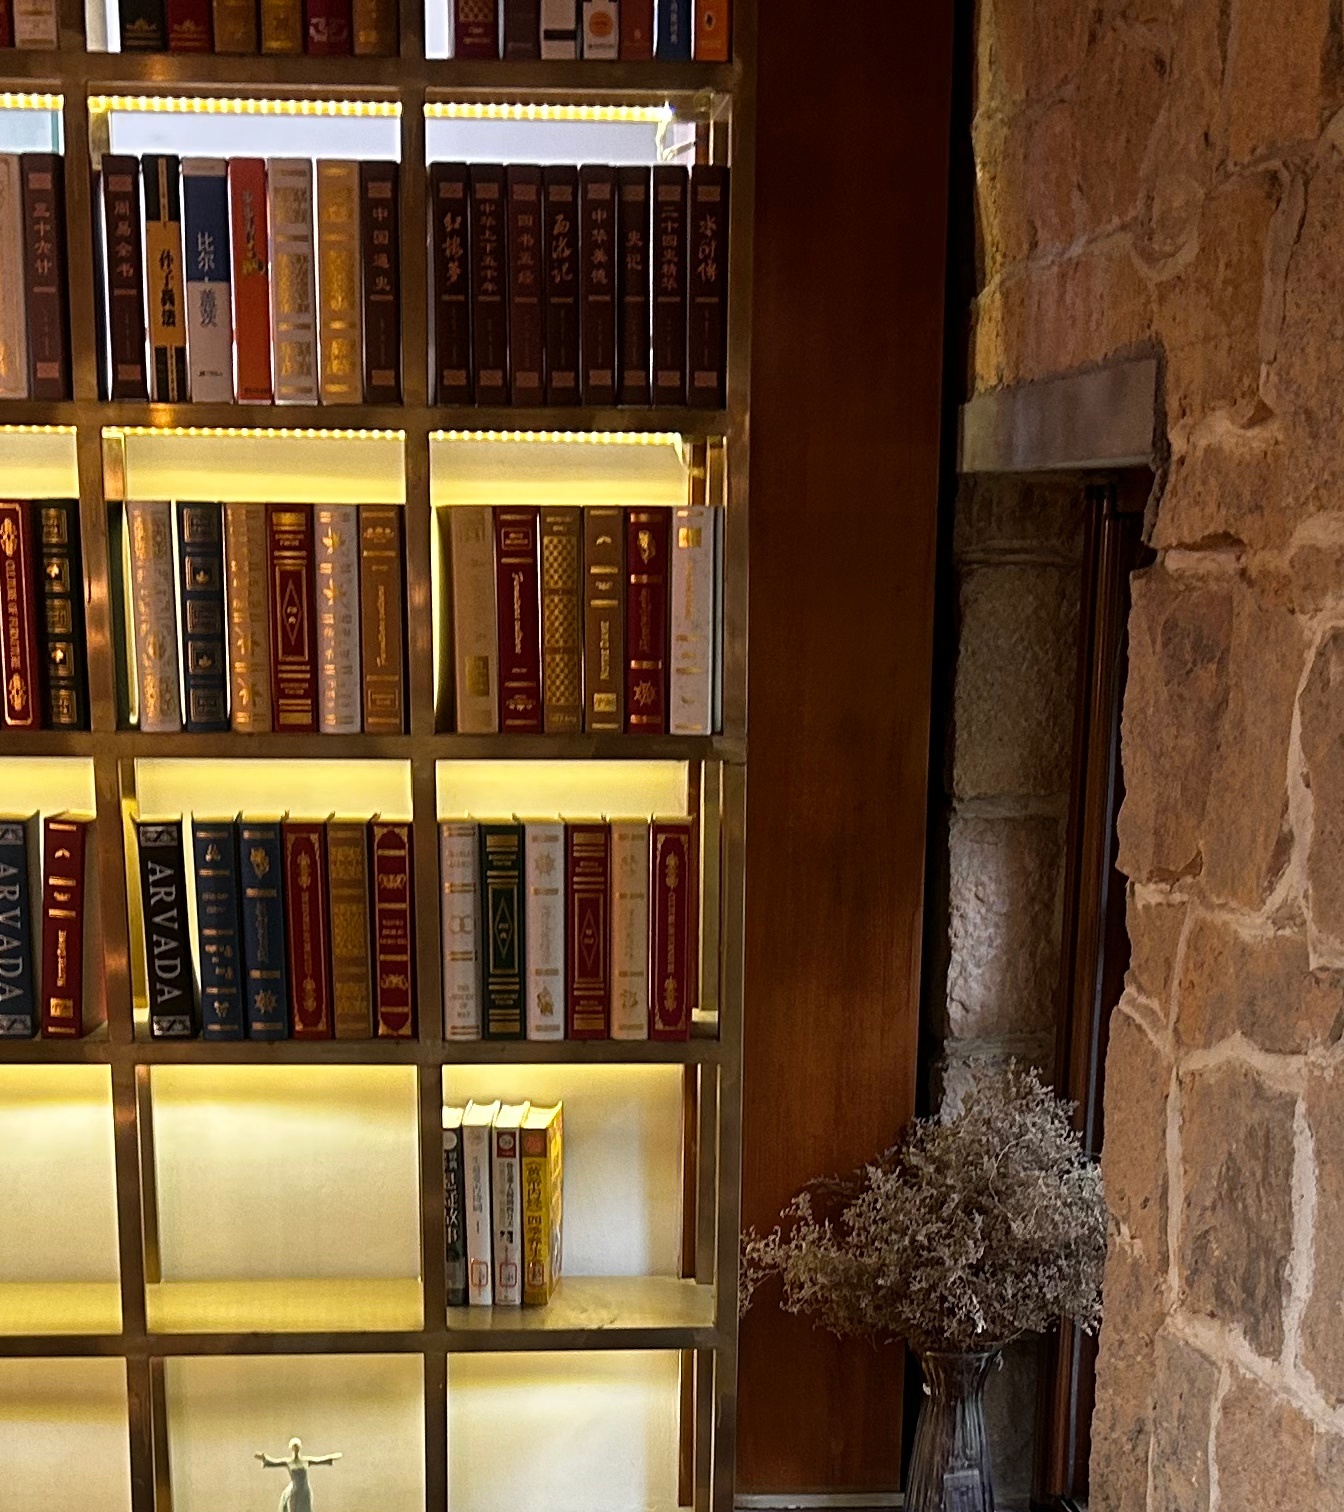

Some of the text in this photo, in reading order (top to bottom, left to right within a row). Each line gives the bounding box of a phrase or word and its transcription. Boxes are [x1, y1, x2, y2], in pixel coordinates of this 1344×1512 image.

[371, 206, 394, 292] 中国通史
[147, 860, 184, 1004] ARVADA
